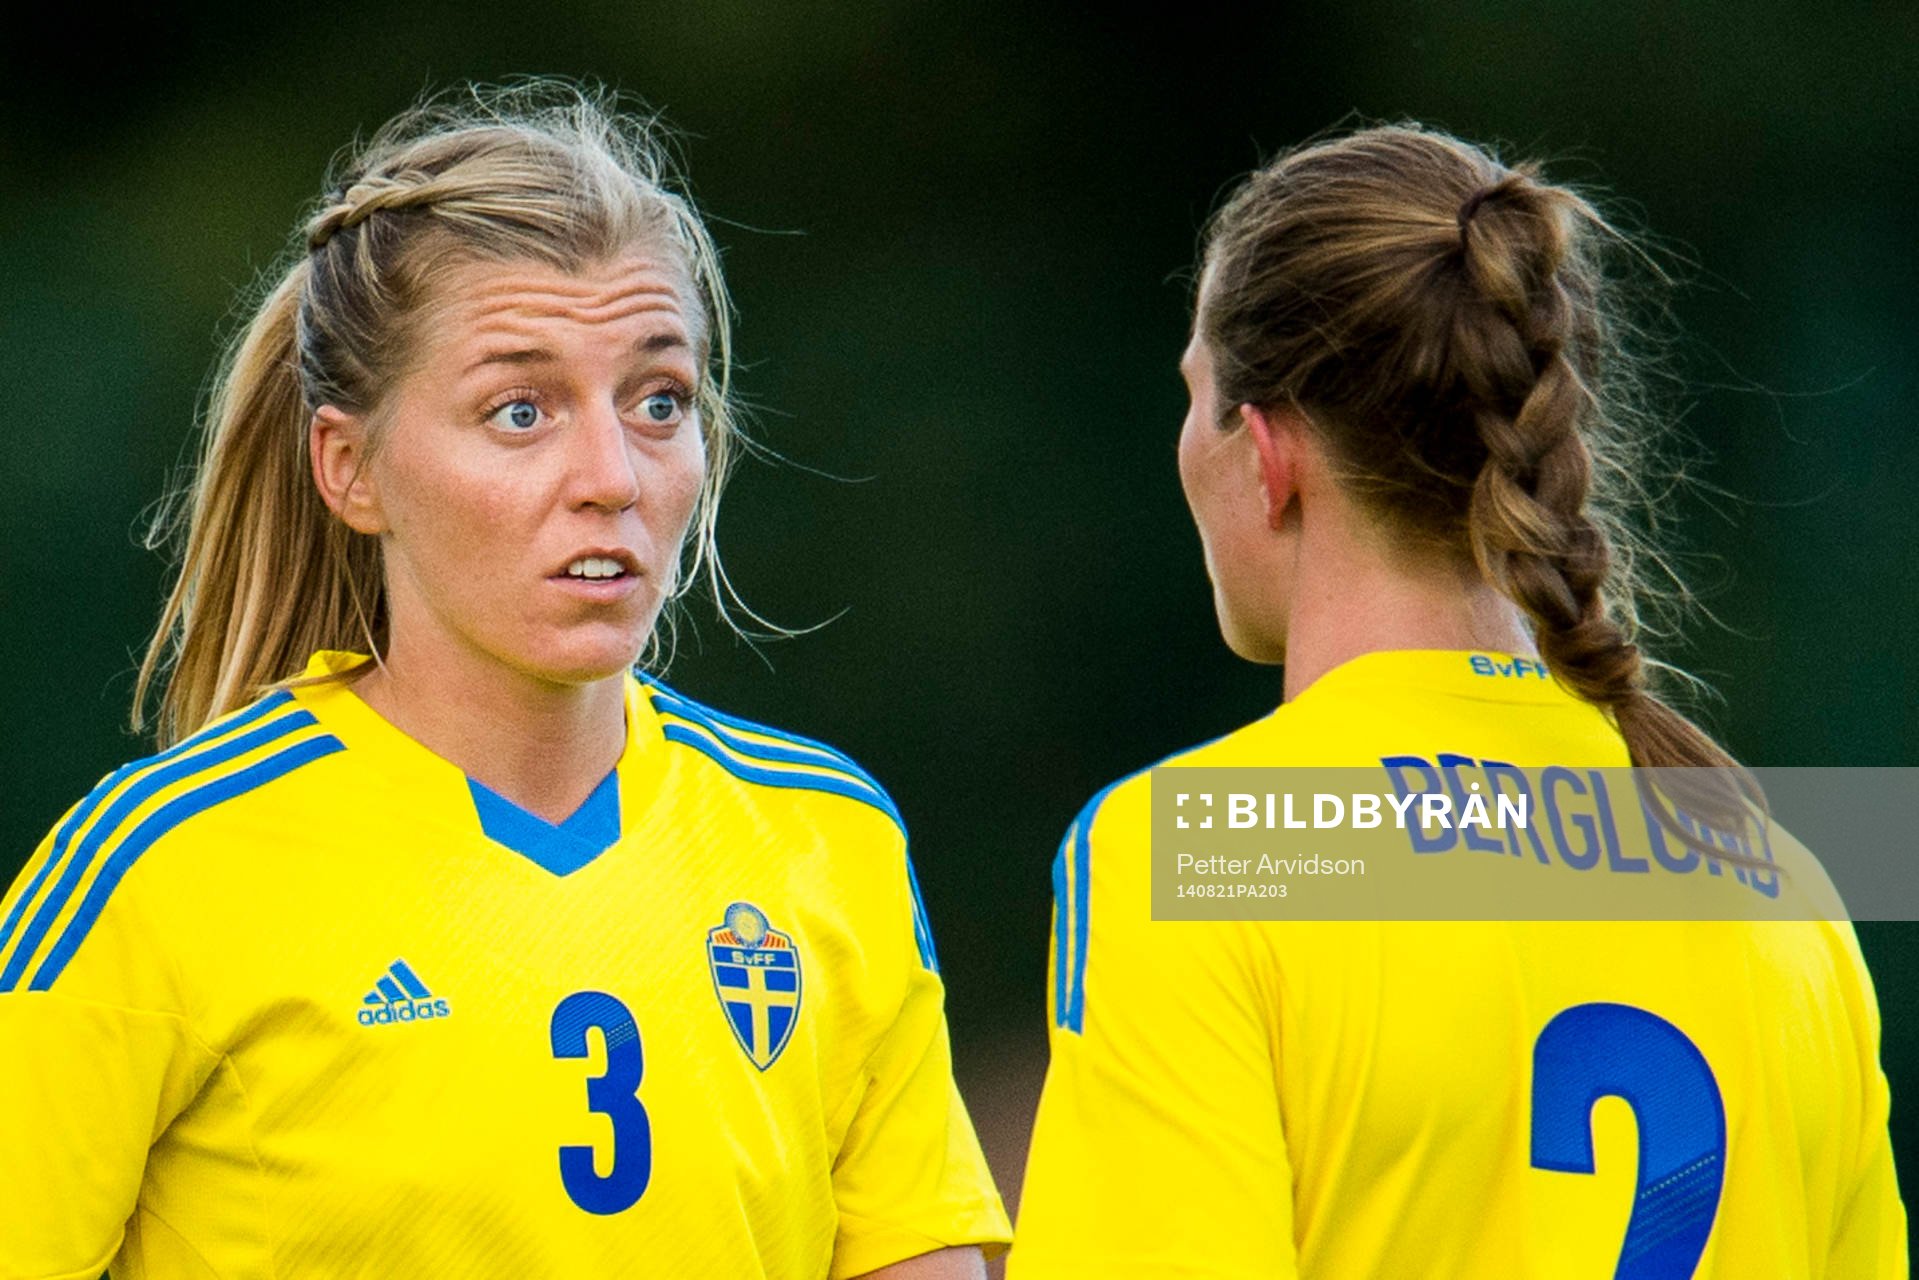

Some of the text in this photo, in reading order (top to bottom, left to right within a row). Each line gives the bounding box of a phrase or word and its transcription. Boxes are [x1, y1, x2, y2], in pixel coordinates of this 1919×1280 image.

[358, 999, 450, 1025] adidas
[731, 950, 776, 965] SvFF
[550, 990, 652, 1216] 3
[1530, 1001, 1727, 1280] 2
